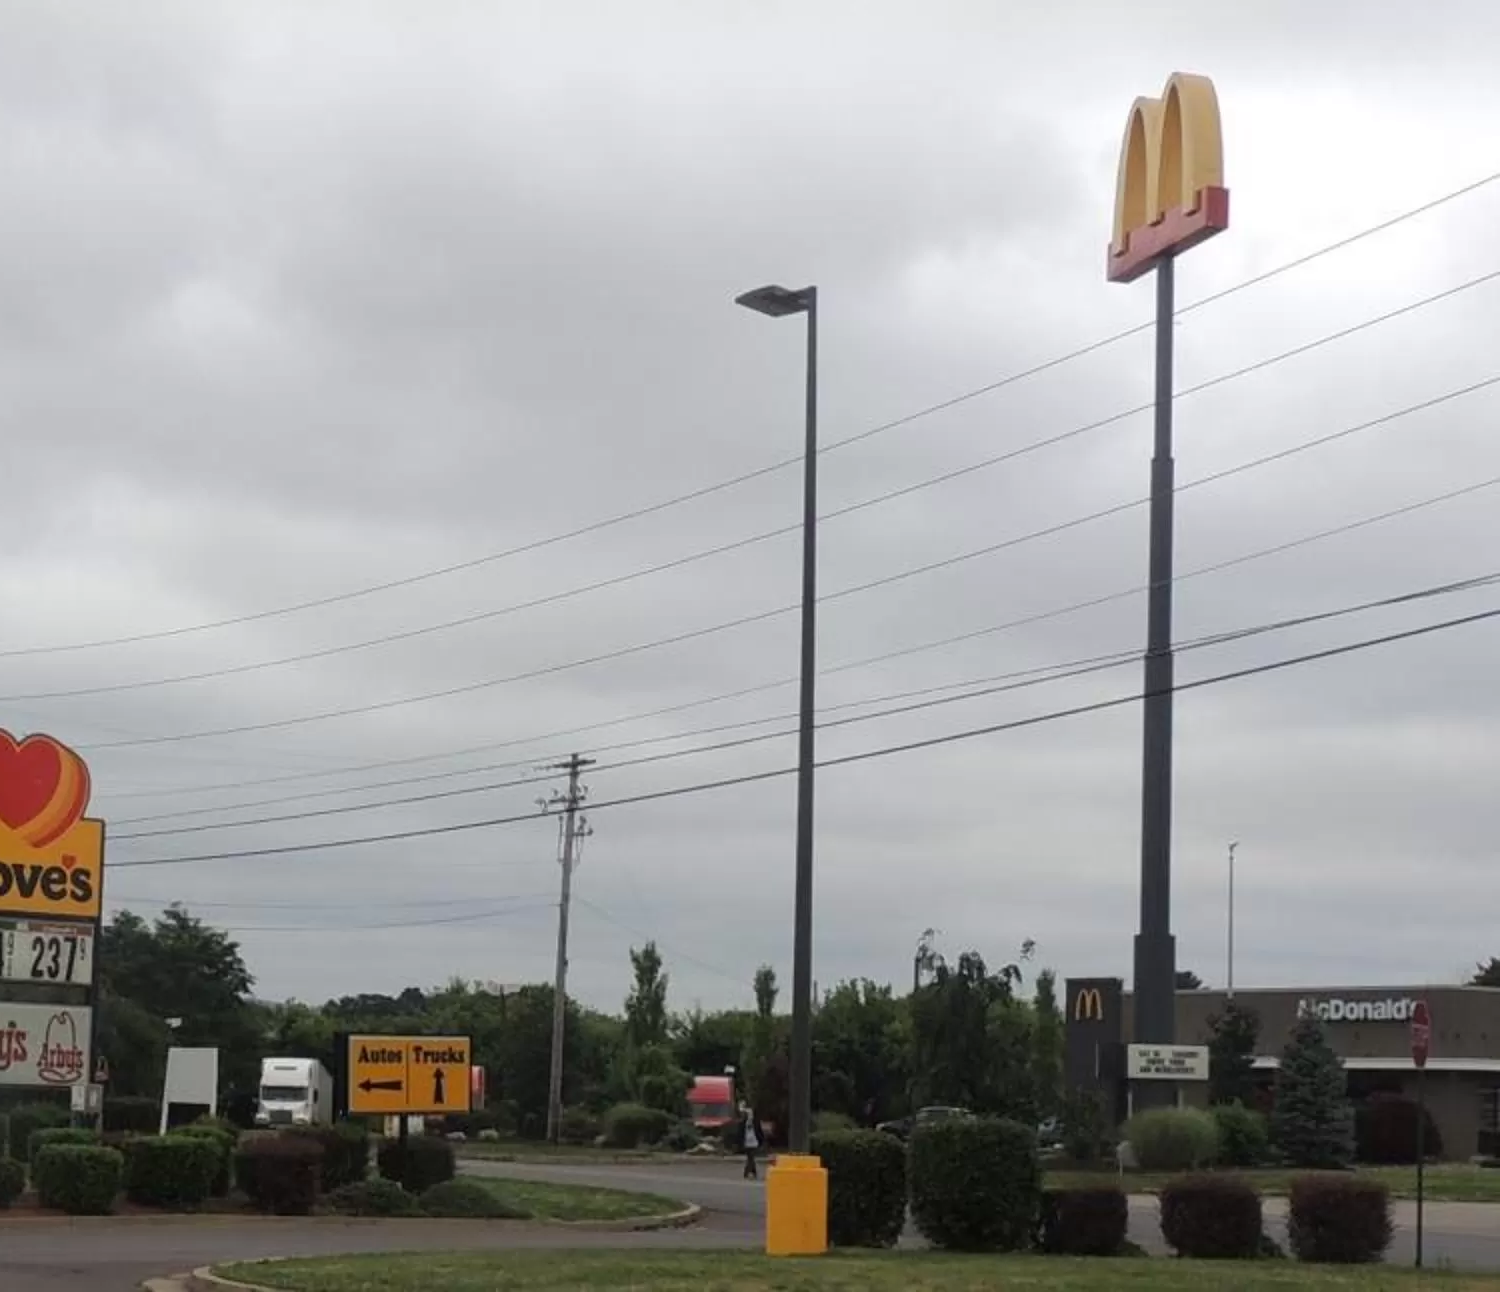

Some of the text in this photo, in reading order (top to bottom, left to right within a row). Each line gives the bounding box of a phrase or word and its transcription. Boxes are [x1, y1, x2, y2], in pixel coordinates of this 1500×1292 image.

[31, 936, 77, 982] 237
[37, 1042, 83, 1072] Arby's
[358, 1045, 403, 1064] Autos
[412, 1045, 465, 1064] Trucks
